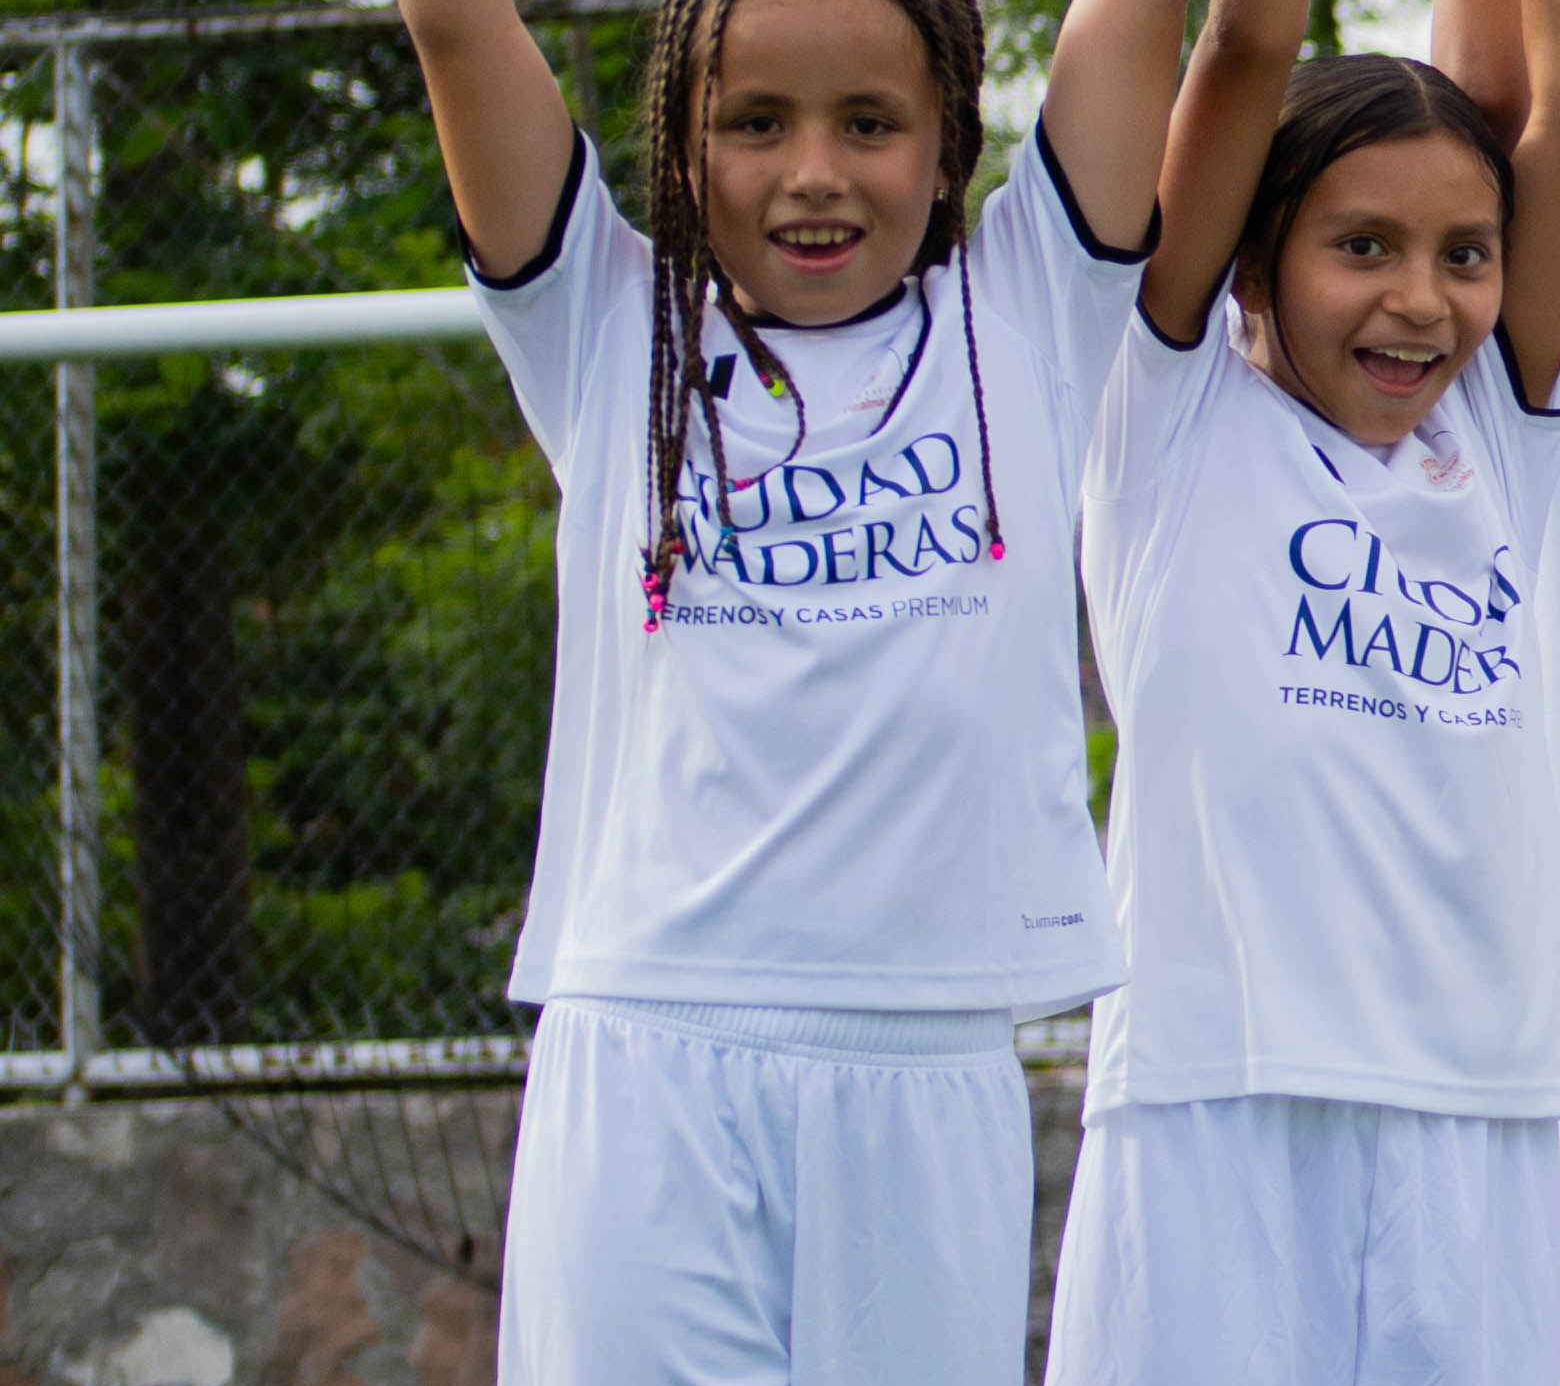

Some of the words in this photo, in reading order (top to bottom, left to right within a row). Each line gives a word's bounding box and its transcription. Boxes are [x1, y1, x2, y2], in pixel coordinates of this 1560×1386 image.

[661, 601, 769, 626] ERRENOS
[768, 608, 785, 628] Y
[796, 603, 884, 625] CASAS
[891, 594, 990, 620] PREMIUM
[1281, 592, 1522, 695] MADER
[1279, 686, 1407, 720] TERRENOS
[1414, 704, 1430, 724] Y
[1438, 707, 1508, 727] CASAS
